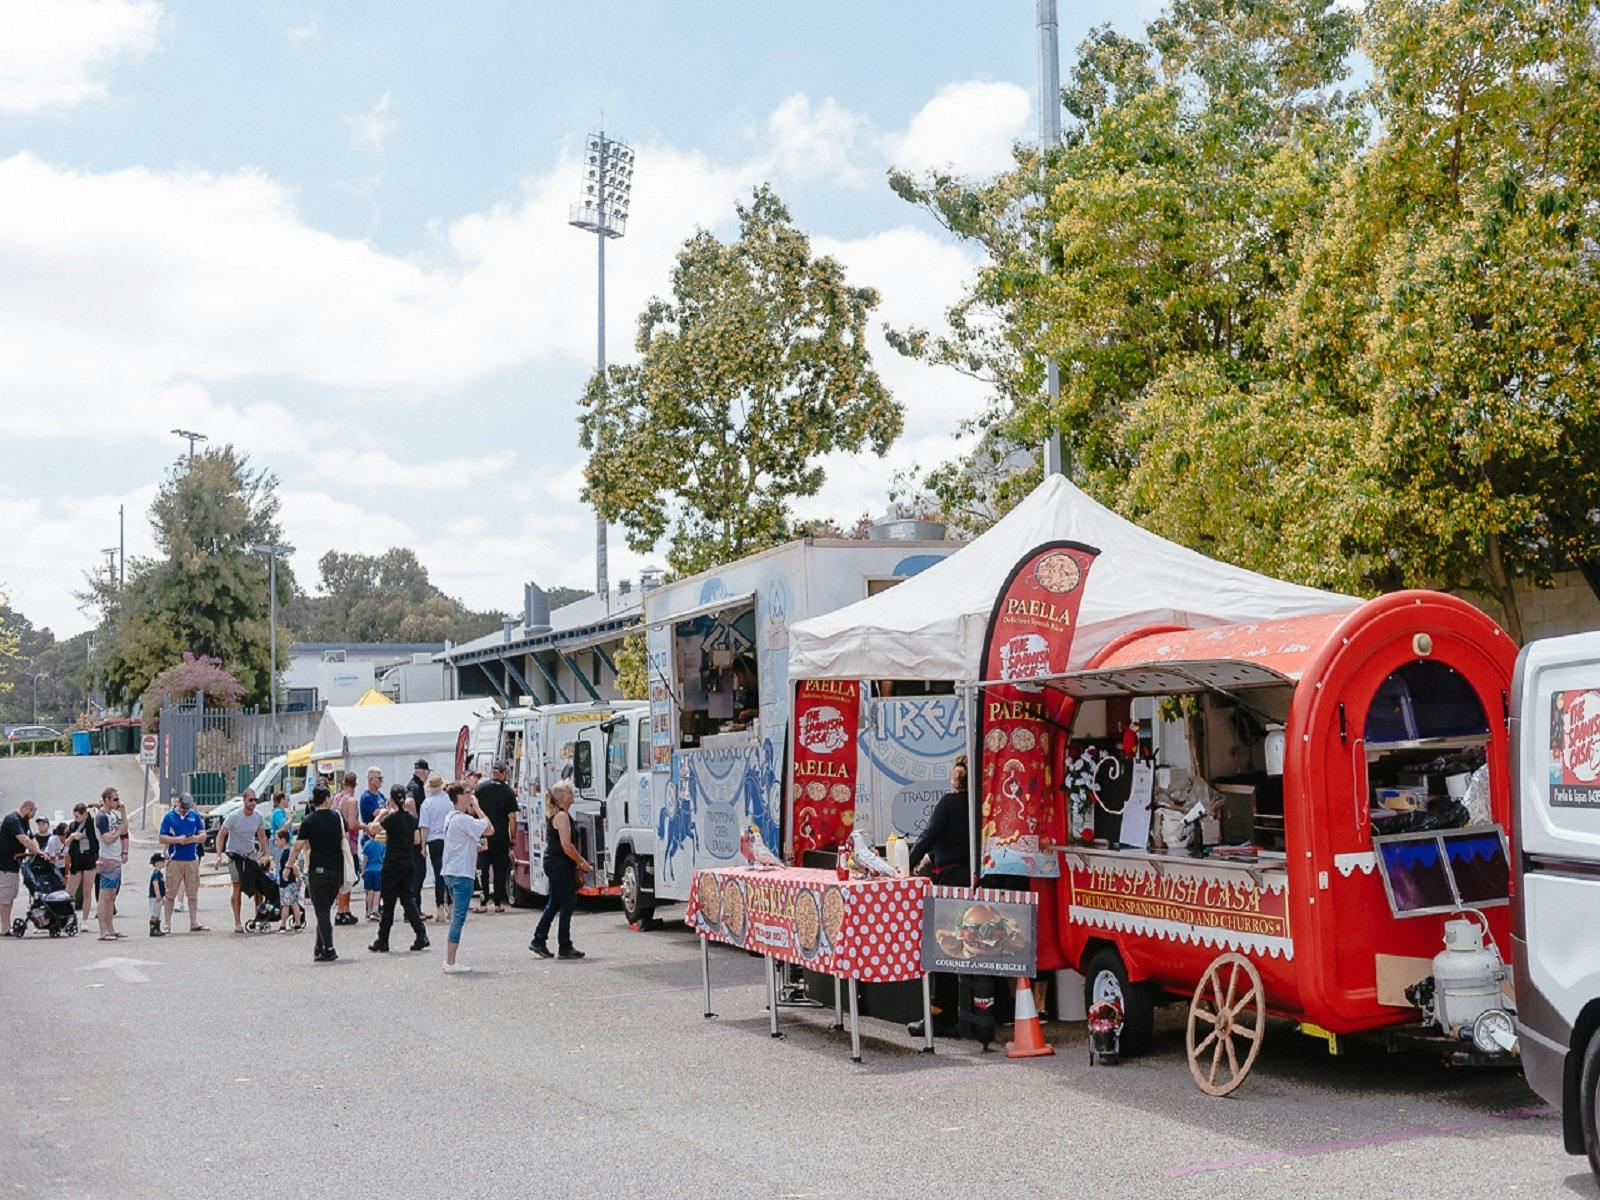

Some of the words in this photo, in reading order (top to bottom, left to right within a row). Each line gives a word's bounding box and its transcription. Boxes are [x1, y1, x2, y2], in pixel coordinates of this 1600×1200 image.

[1003, 616, 1030, 625] Delicious
[1007, 599, 1070, 625] PAELLA
[805, 680, 856, 697] PAELLA
[989, 701, 1047, 722] PAELL
[1570, 700, 1585, 726] THE
[1568, 713, 1600, 748] SPANIS
[794, 760, 849, 778] PAELLA
[1089, 866, 1117, 892] THE
[1121, 869, 1199, 905] SPANISH
[1204, 880, 1260, 912] CASA
[1082, 894, 1125, 911] DELICIOUS
[1125, 901, 1164, 917] SPANISH
[1165, 906, 1194, 923] FOOD
[1195, 911, 1219, 927] AND
[1220, 914, 1275, 935] CHURROS
[936, 959, 970, 968] GOURMET
[971, 961, 995, 970] ANGUS
